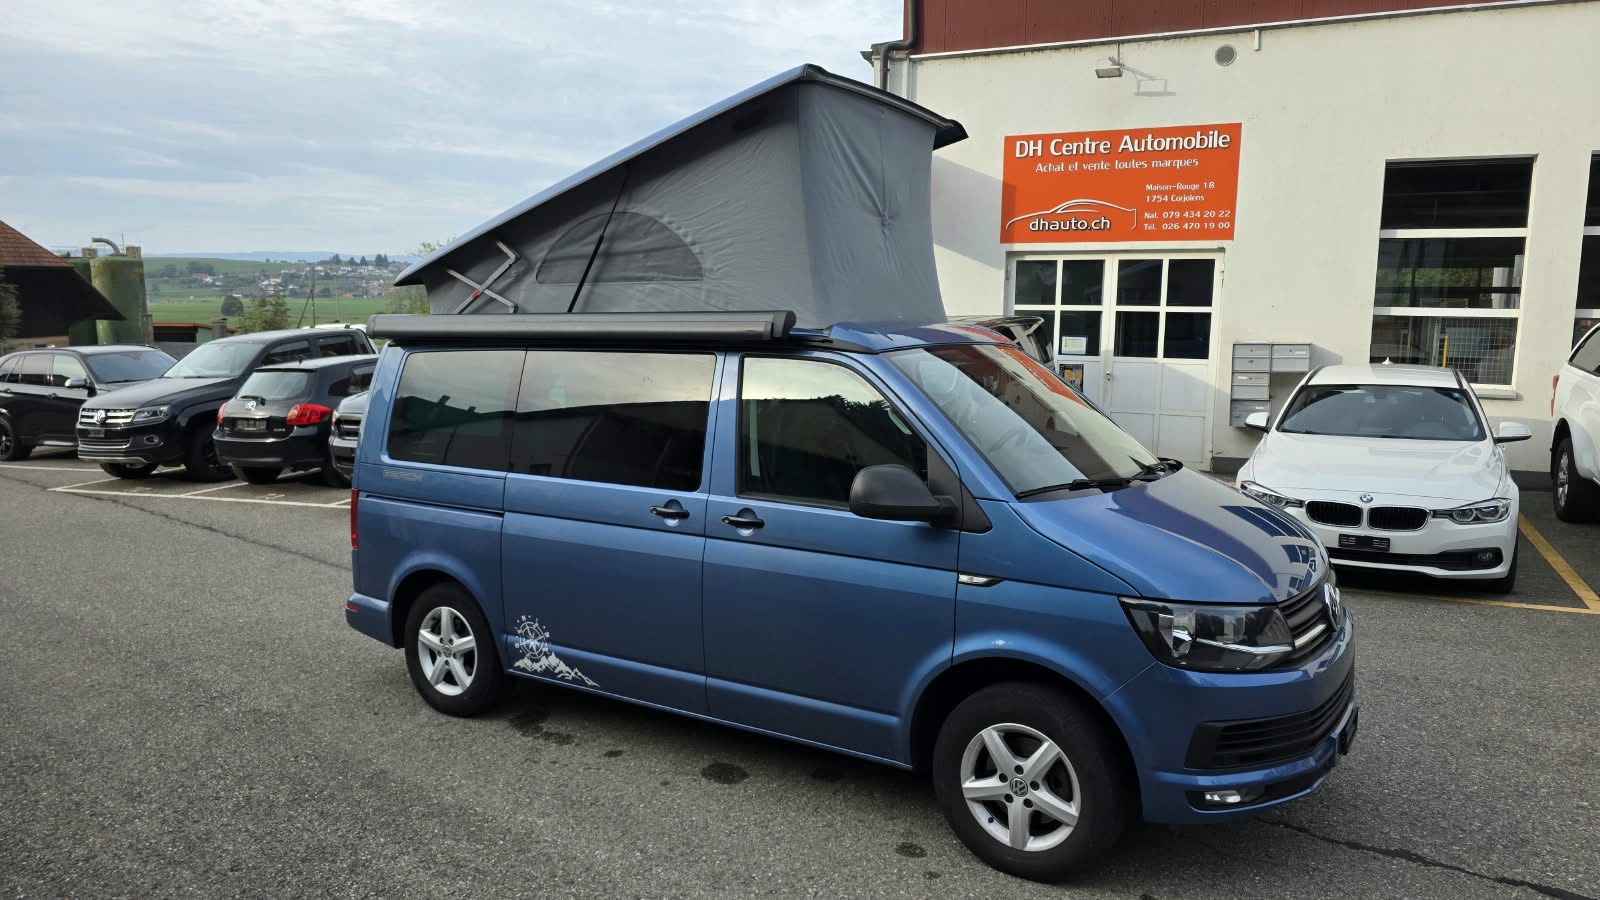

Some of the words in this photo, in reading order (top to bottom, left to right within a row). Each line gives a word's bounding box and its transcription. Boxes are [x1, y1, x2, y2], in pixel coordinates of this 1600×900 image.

[1015, 139, 1043, 158] DH
[1050, 137, 1111, 156] Centre
[1118, 130, 1231, 153] Automobile
[1035, 161, 1064, 173] Achat
[1068, 161, 1078, 171] et
[1082, 160, 1111, 170] vente
[1115, 159, 1148, 169] toutes
[1151, 158, 1199, 169] marques
[1145, 182, 1200, 191] Maison-Rouge
[1203, 181, 1215, 189] 18
[1146, 195, 1168, 203] 1754
[1162, 211, 1180, 219] 079
[1203, 210, 1216, 218] 20
[1218, 210, 1231, 218] 22
[1029, 216, 1111, 231] dhauto.ch
[1162, 222, 1180, 230] 026
[1183, 222, 1200, 230] 470
[1218, 221, 1230, 229] 00
